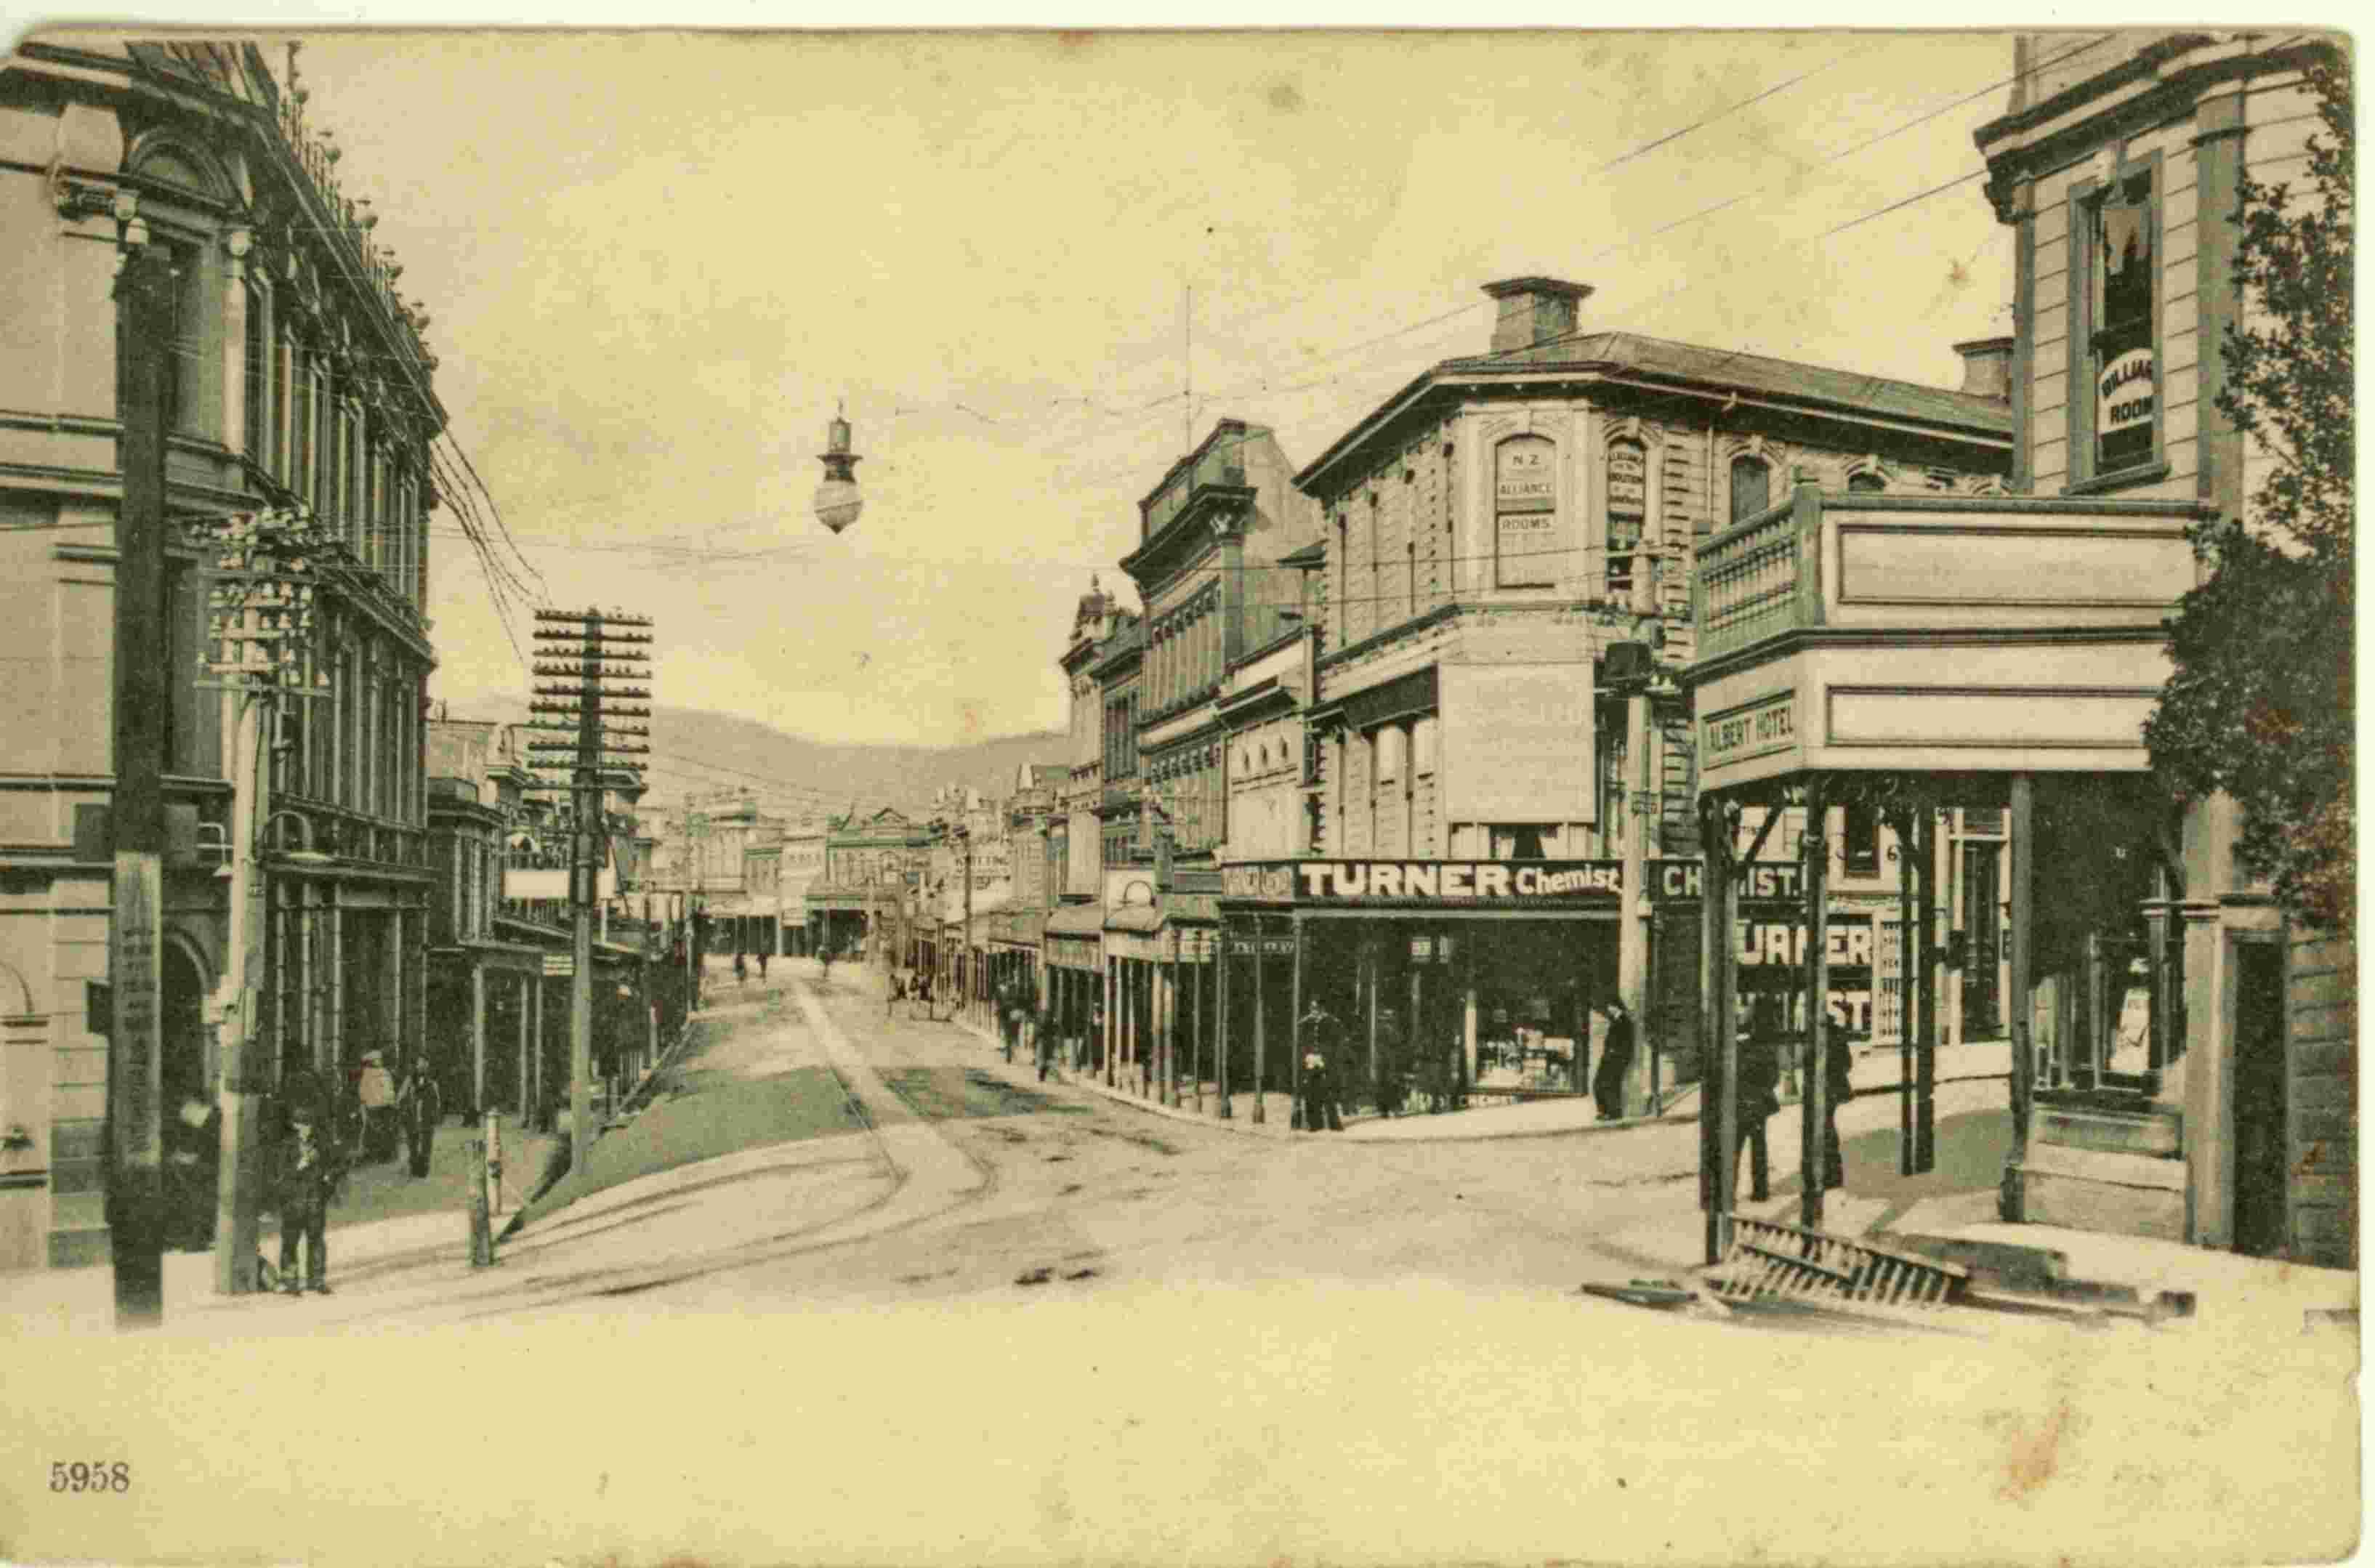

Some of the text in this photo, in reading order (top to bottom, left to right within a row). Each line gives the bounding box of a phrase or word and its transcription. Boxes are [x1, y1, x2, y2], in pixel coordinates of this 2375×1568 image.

[1499, 482, 1552, 495] ALLIANCE
[1501, 517, 1550, 530] ROOMS
[1709, 706, 1794, 752] ALBERT HOTEL
[1299, 863, 1511, 896] TURNER
[1515, 863, 1623, 896] Chemist
[1663, 866, 1799, 897] CHIST.
